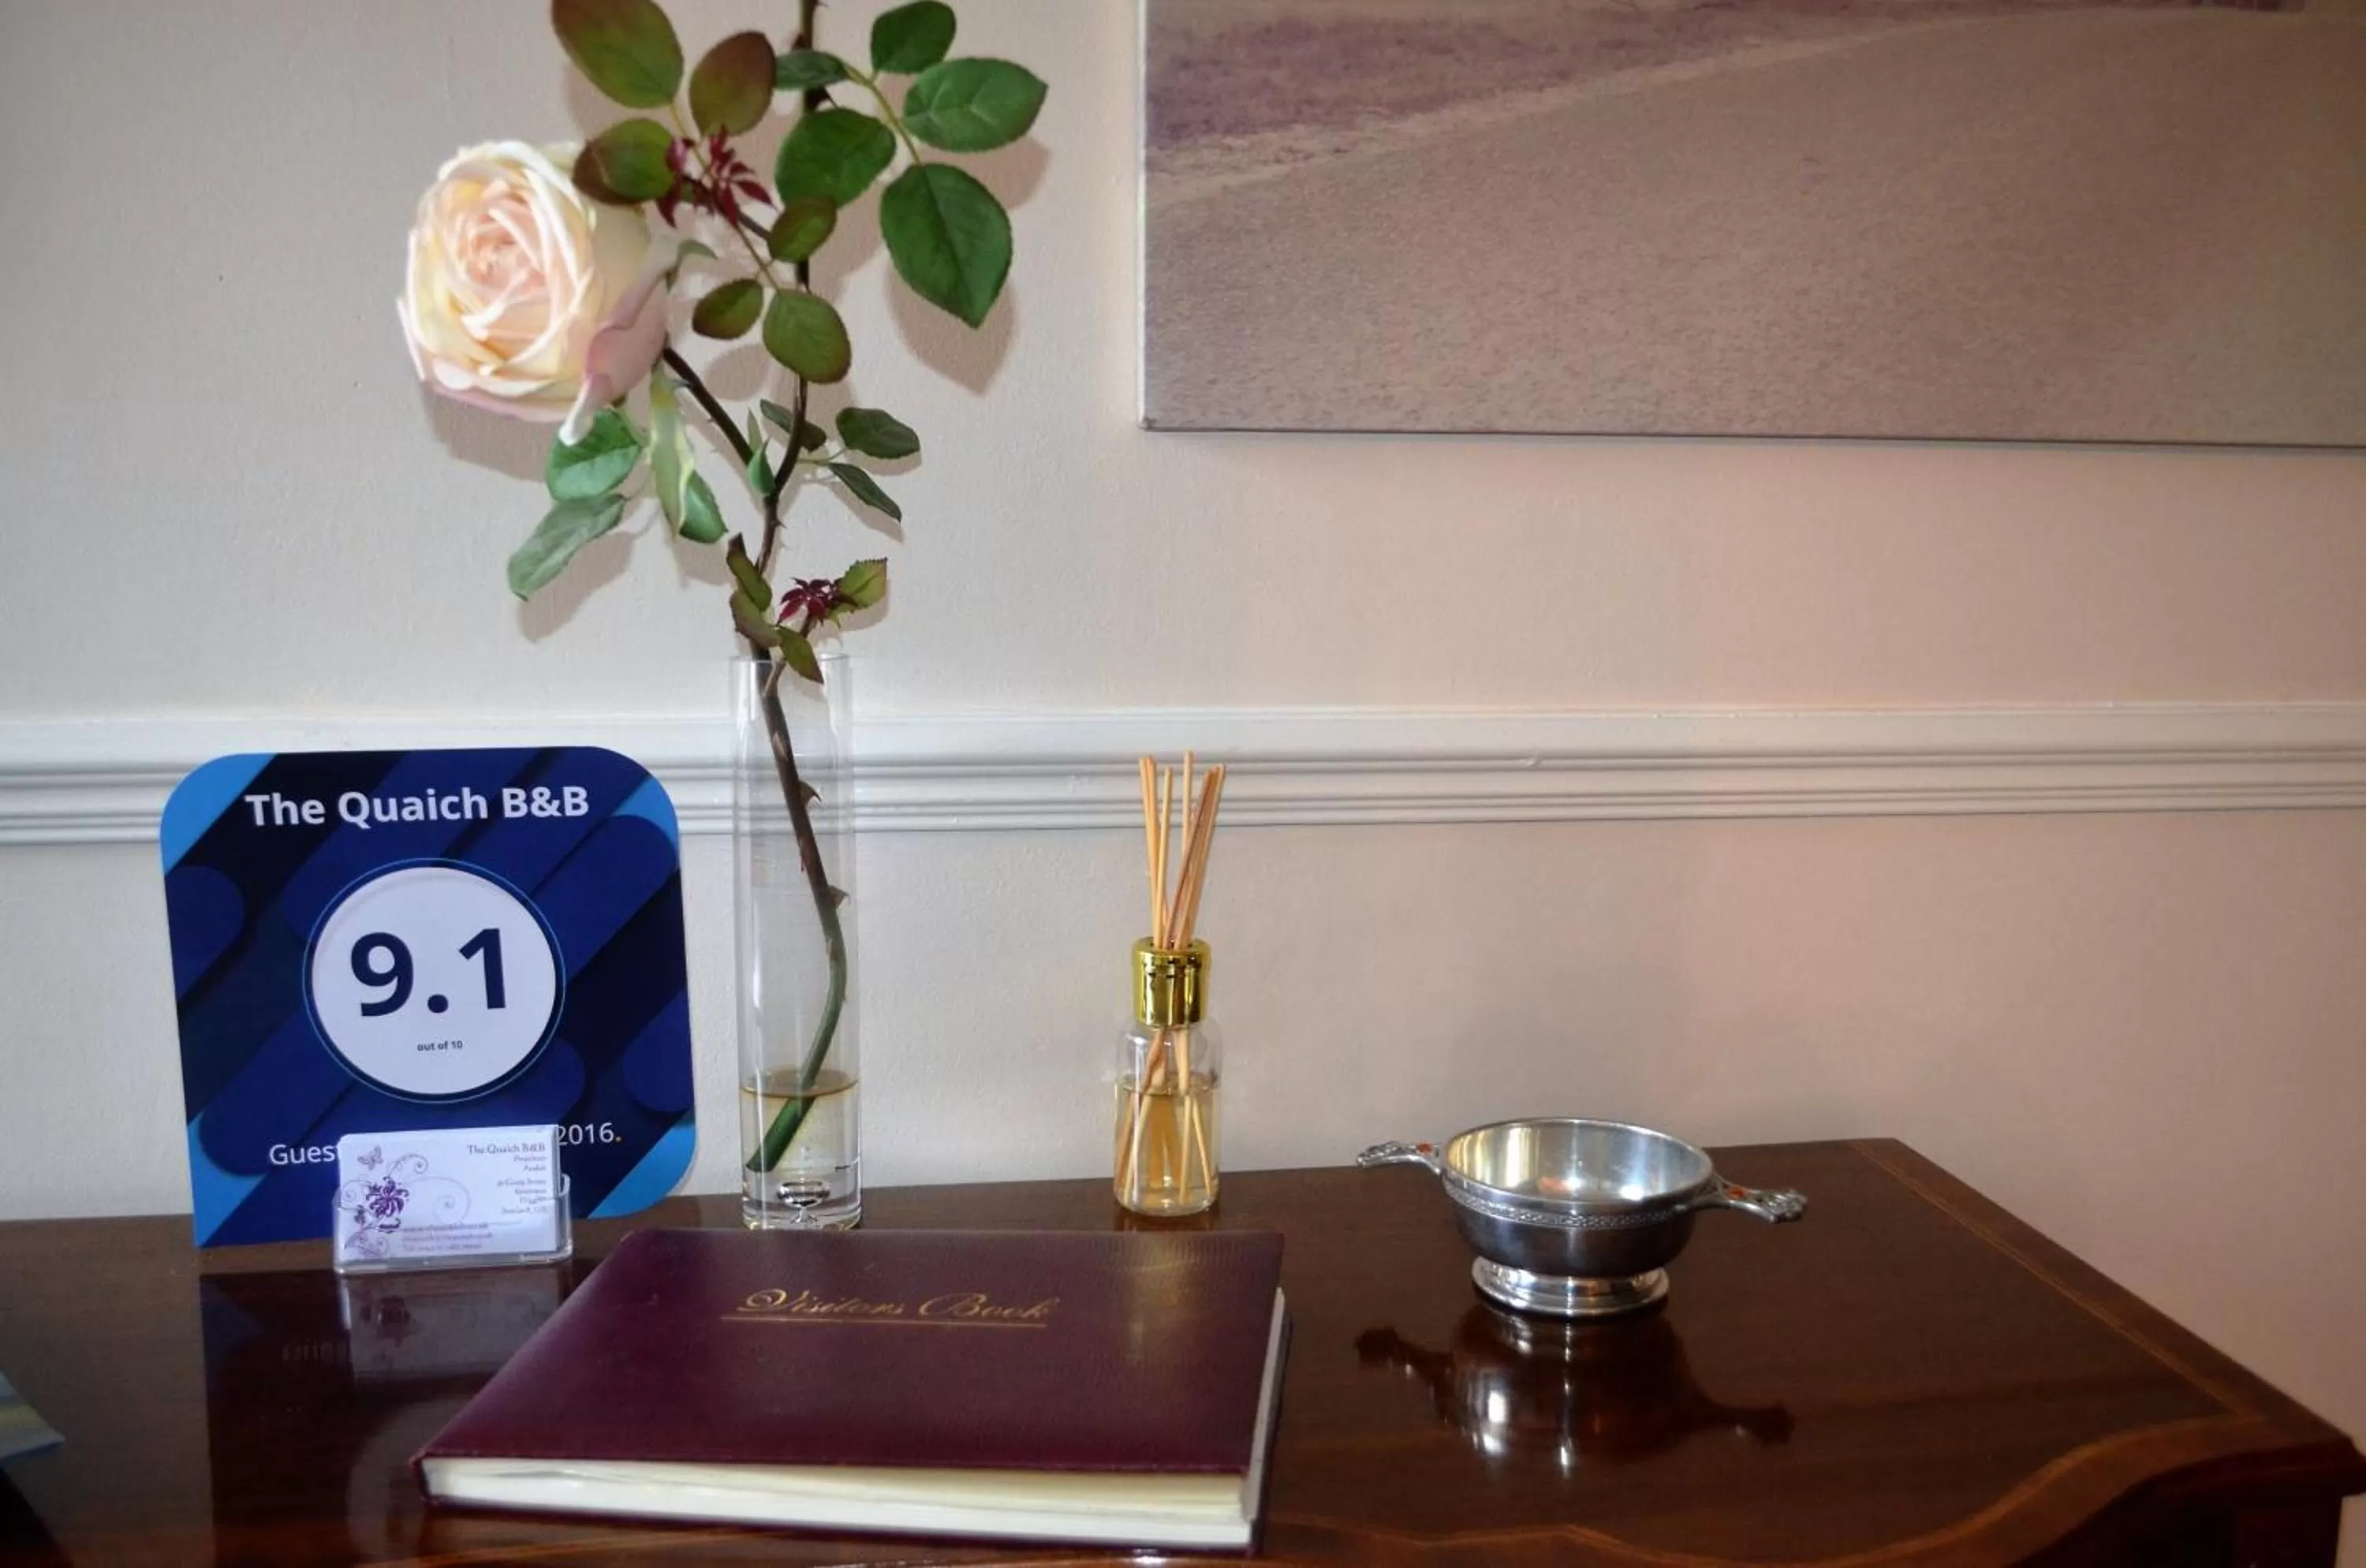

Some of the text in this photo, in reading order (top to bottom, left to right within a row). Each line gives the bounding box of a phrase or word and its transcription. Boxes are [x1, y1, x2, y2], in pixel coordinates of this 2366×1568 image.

[245, 786, 590, 829] The Quaich B&B
[351, 928, 506, 1017] 9.1
[417, 1040, 463, 1051] out of 10
[269, 1144, 338, 1165] Gues
[466, 1144, 486, 1155] The
[736, 1287, 1061, 1320] Visitors Book
